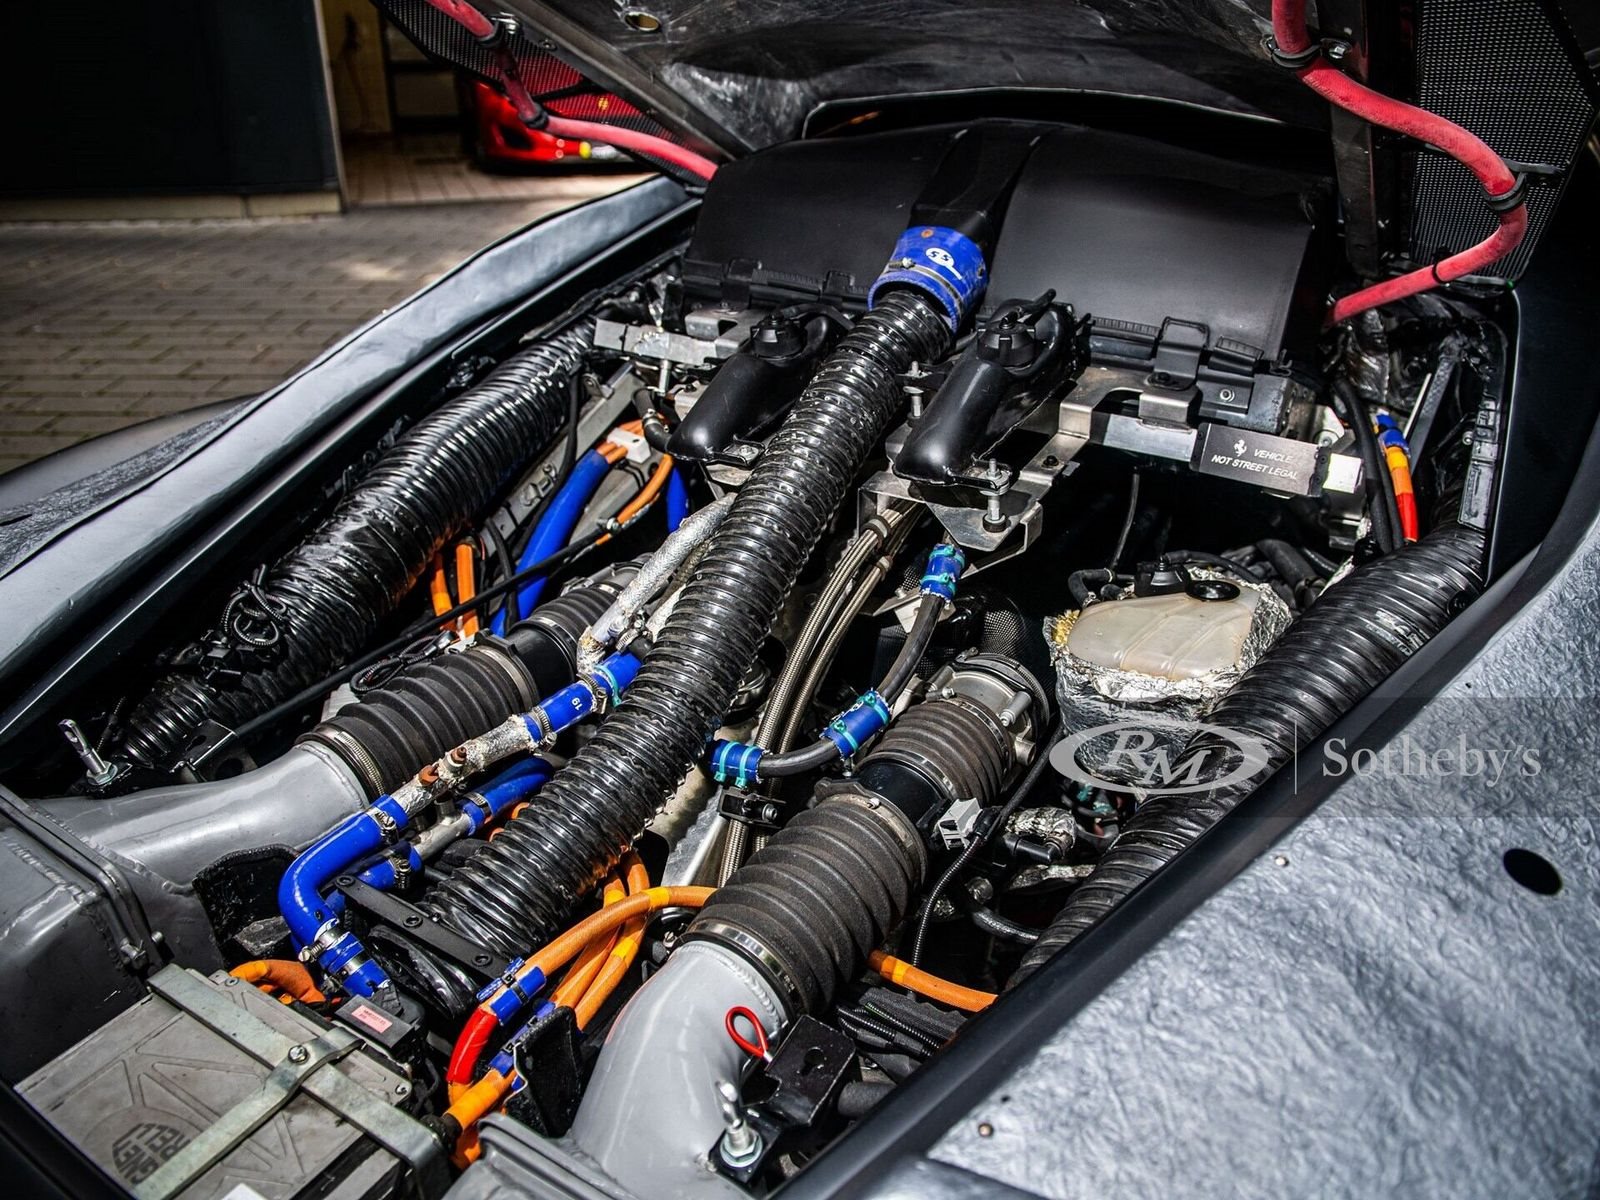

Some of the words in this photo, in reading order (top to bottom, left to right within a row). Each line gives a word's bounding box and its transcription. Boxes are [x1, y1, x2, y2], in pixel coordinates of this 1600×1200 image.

[1253, 448, 1294, 463] VEHICLE
[1211, 454, 1233, 465] NOT
[1231, 458, 1270, 473] STREET
[1267, 466, 1298, 480] LEGAL
